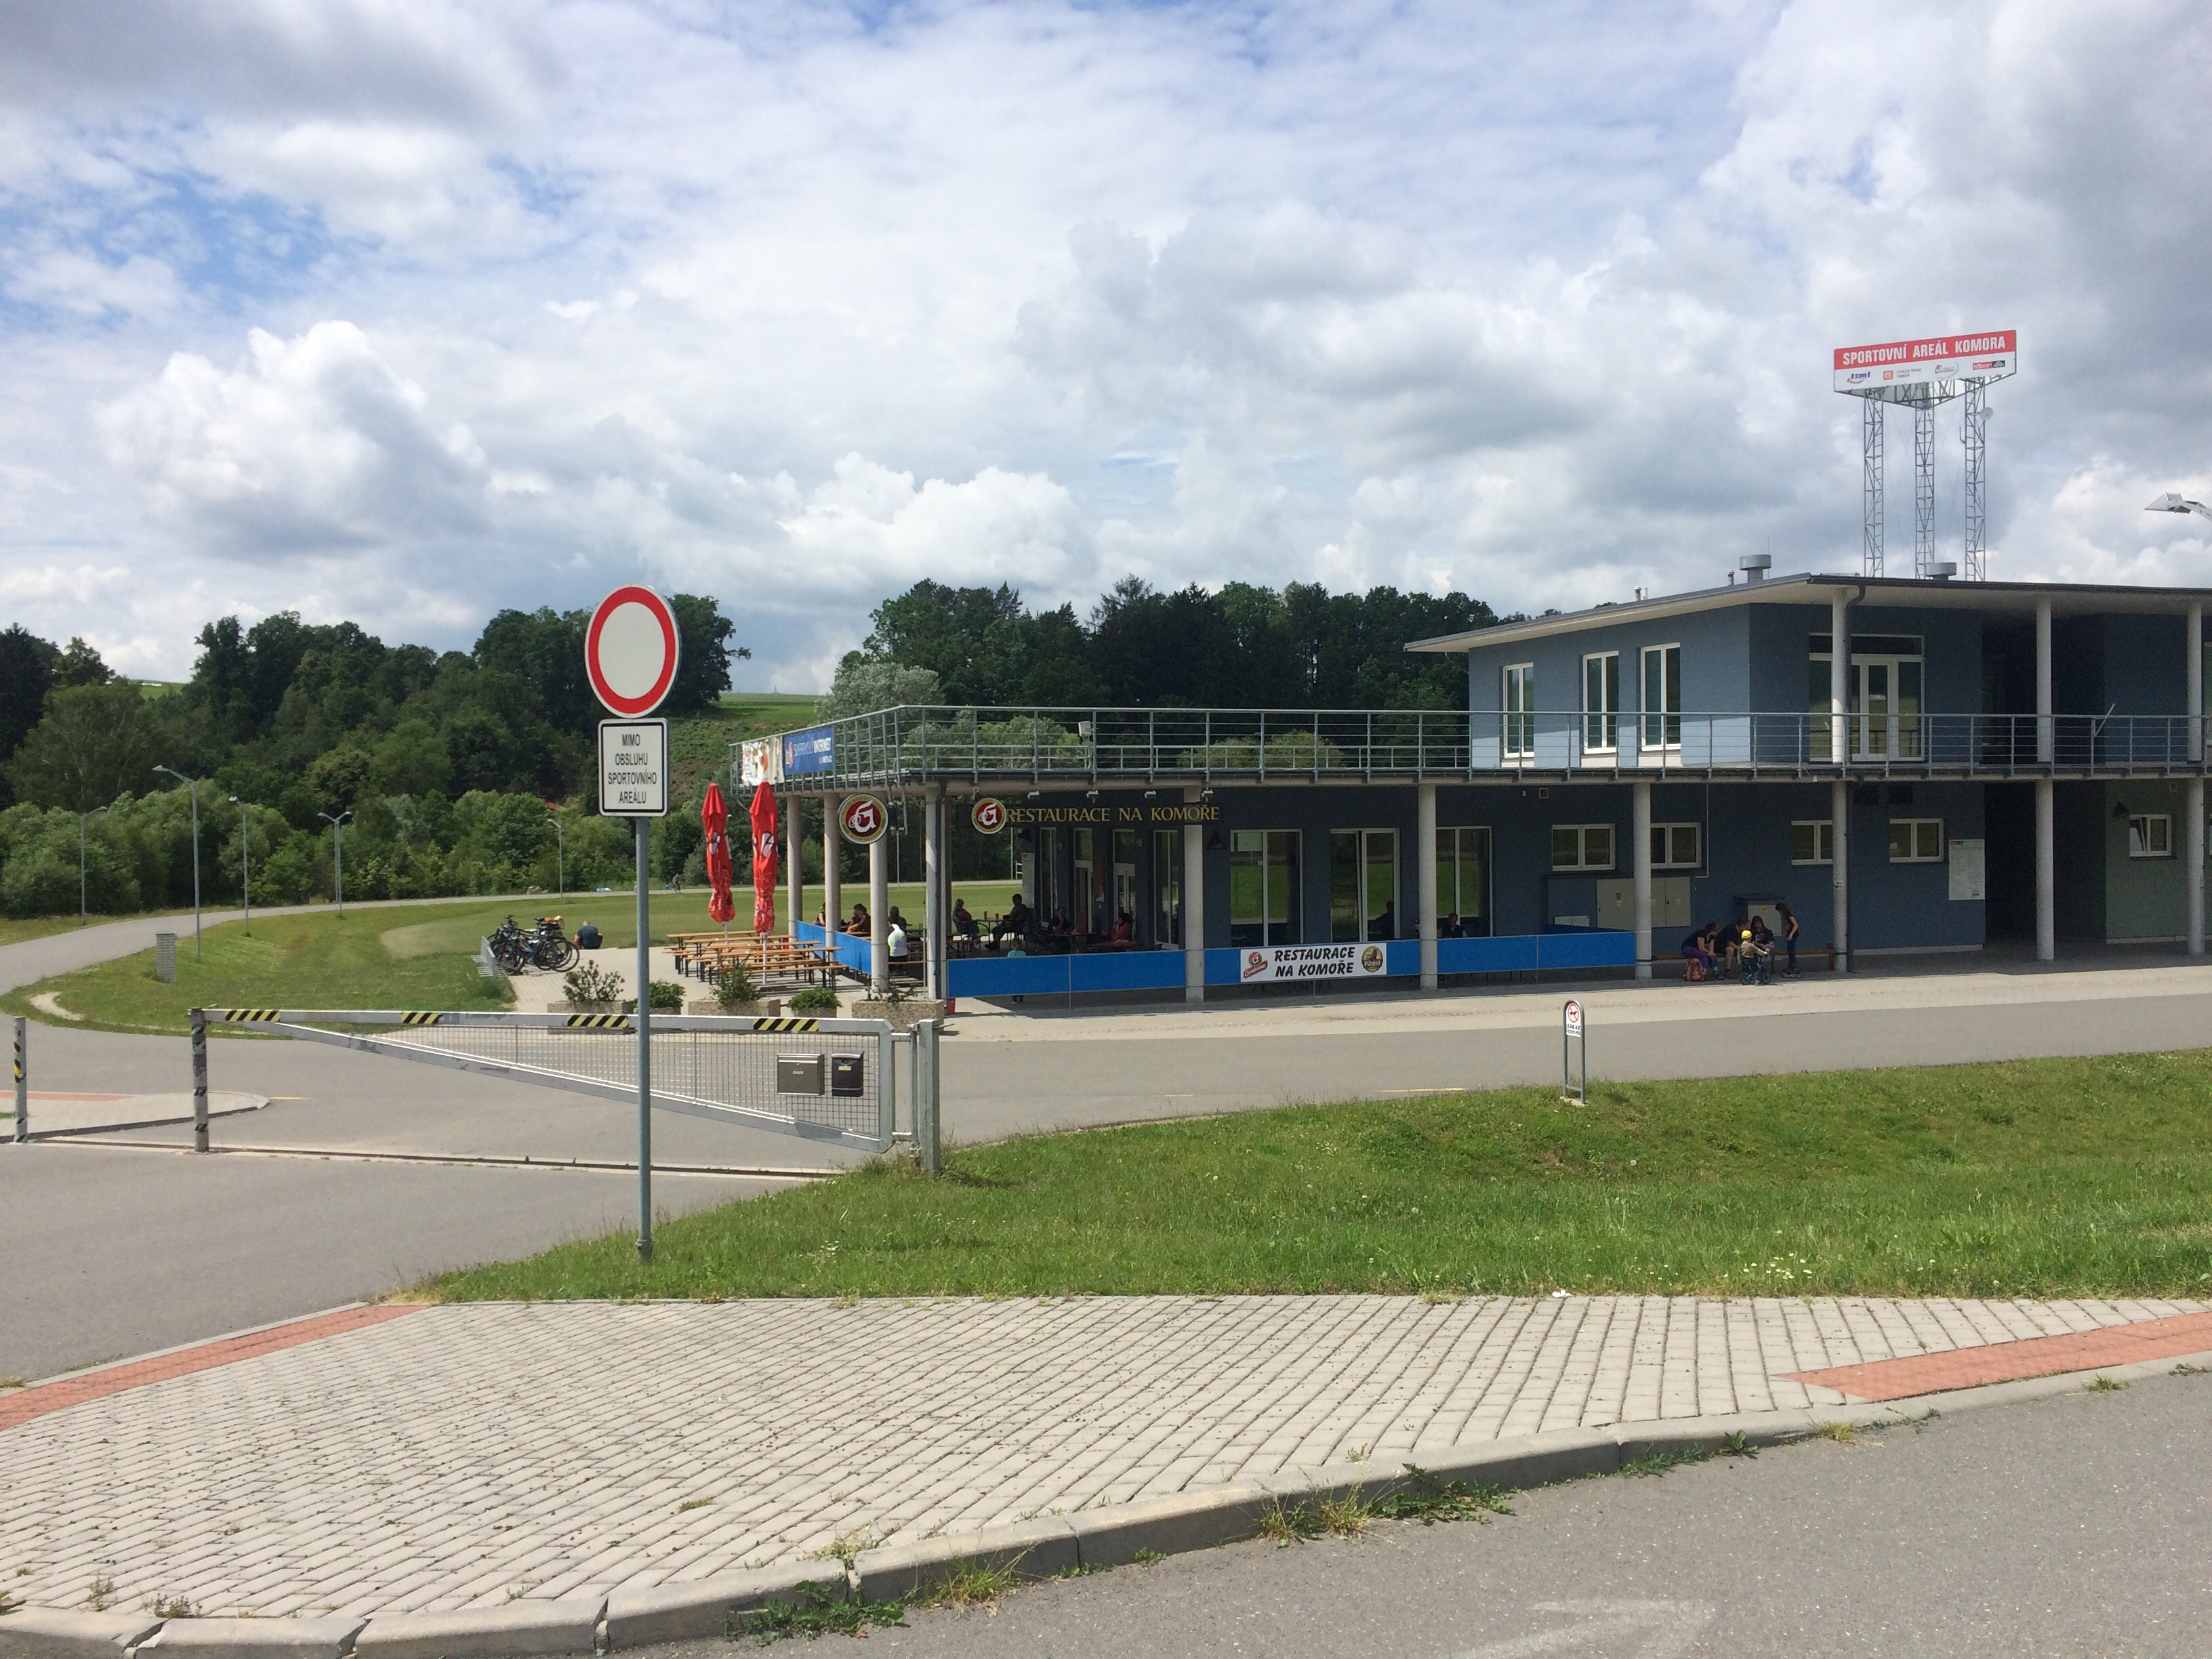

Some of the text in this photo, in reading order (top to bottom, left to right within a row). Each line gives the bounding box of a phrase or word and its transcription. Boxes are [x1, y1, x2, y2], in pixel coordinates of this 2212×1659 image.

[1843, 336, 2006, 365] SPORTOVNÍ AREÁL KOMORA
[621, 734, 640, 746] MIMO
[615, 753, 649, 766] OBSLUHU
[608, 769, 657, 785] SPORTOVNÍHO
[619, 787, 647, 804] AREÁLU
[1007, 804, 1219, 823] RESTAURACE NA KOMOŘE
[1274, 947, 1355, 962] RESTAURACE
[1275, 965, 1294, 977] NA
[1298, 960, 1354, 977] KOMOŘE
